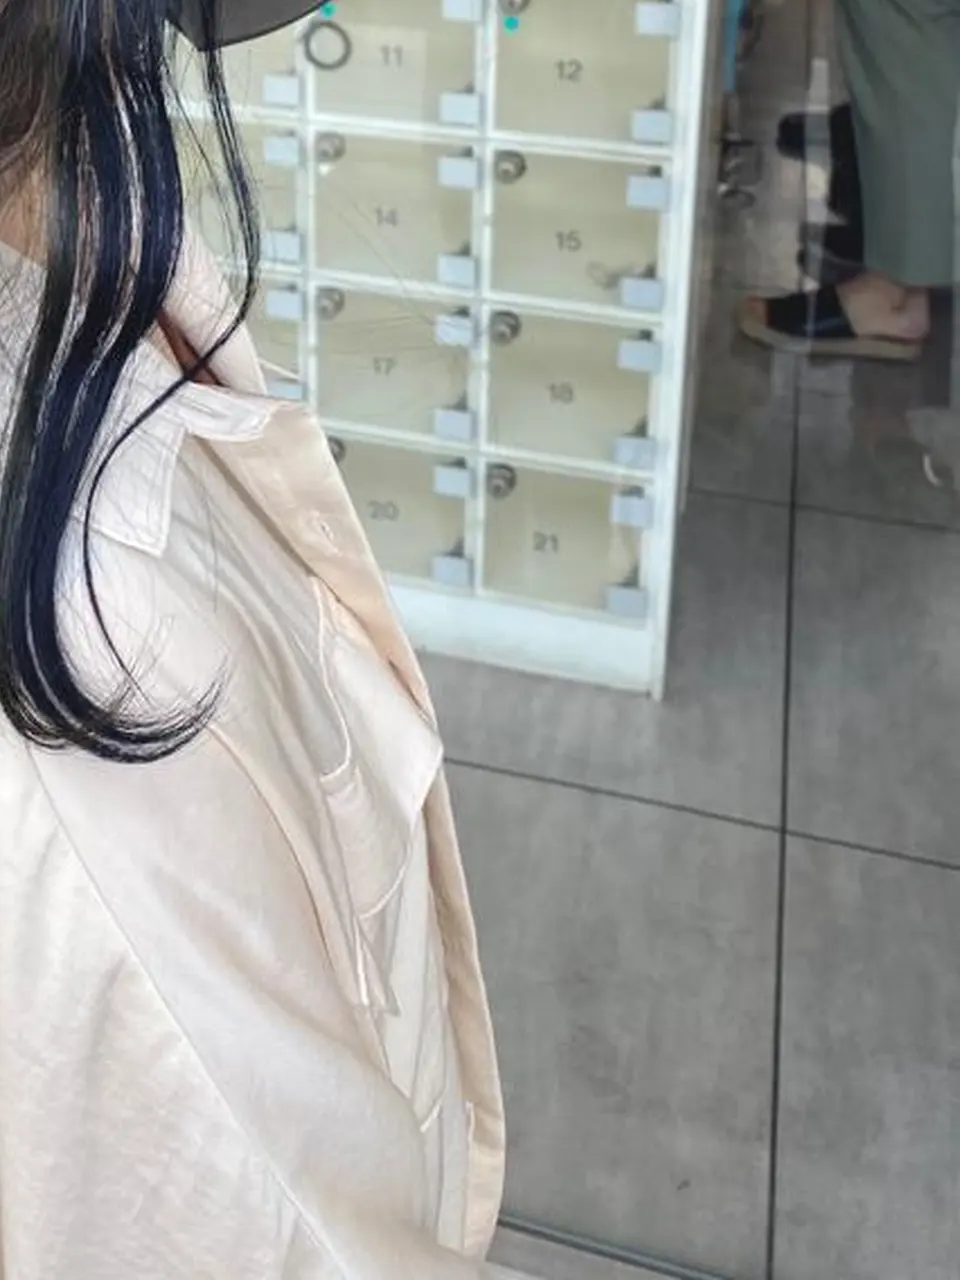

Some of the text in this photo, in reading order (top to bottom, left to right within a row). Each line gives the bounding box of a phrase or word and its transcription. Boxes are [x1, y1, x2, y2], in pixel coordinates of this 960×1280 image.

[380, 45, 403, 67] 11
[555, 60, 582, 81] 12
[375, 208, 398, 227] 14
[555, 231, 581, 252] 15
[373, 358, 396, 375] 17
[548, 383, 574, 403] 18
[367, 501, 399, 520] 20
[533, 532, 558, 552] 21
